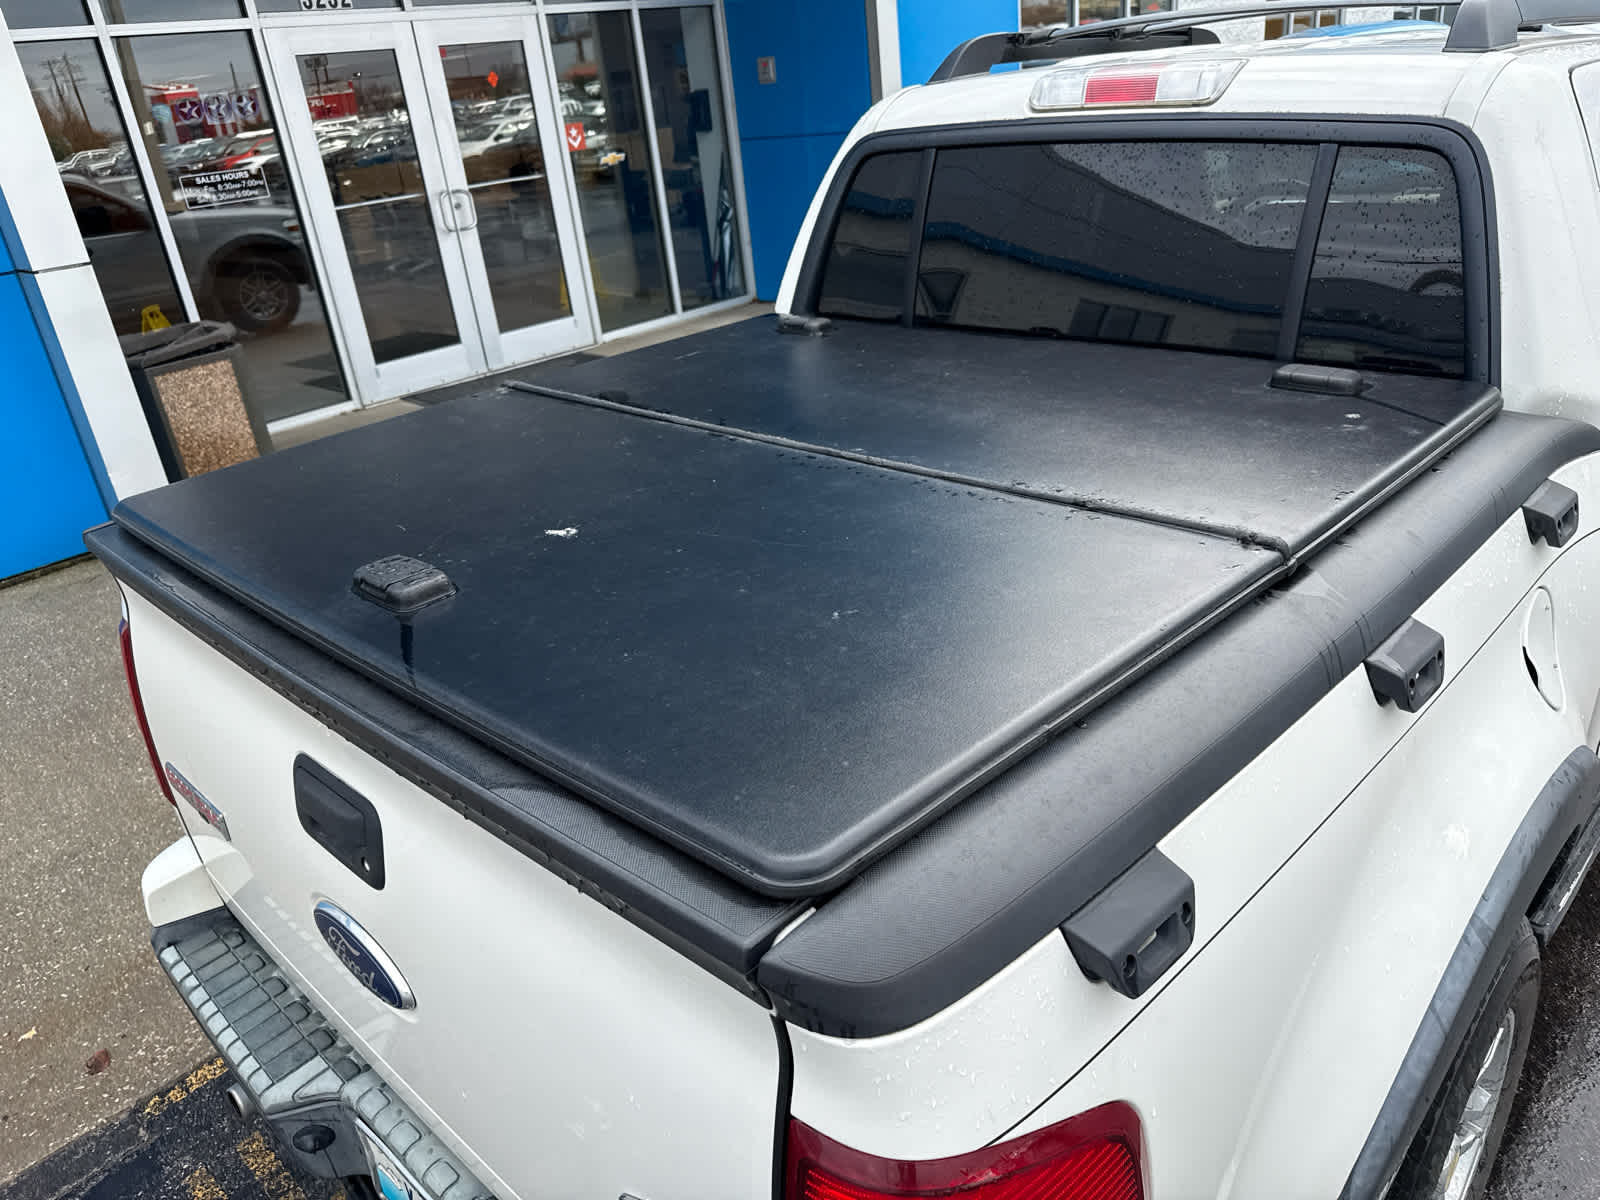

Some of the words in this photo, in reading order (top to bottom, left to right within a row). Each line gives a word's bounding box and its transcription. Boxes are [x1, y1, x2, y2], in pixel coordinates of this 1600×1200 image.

[195, 175, 221, 184] SALES
[222, 171, 249, 181] HOURS
[327, 926, 378, 992] Ford
